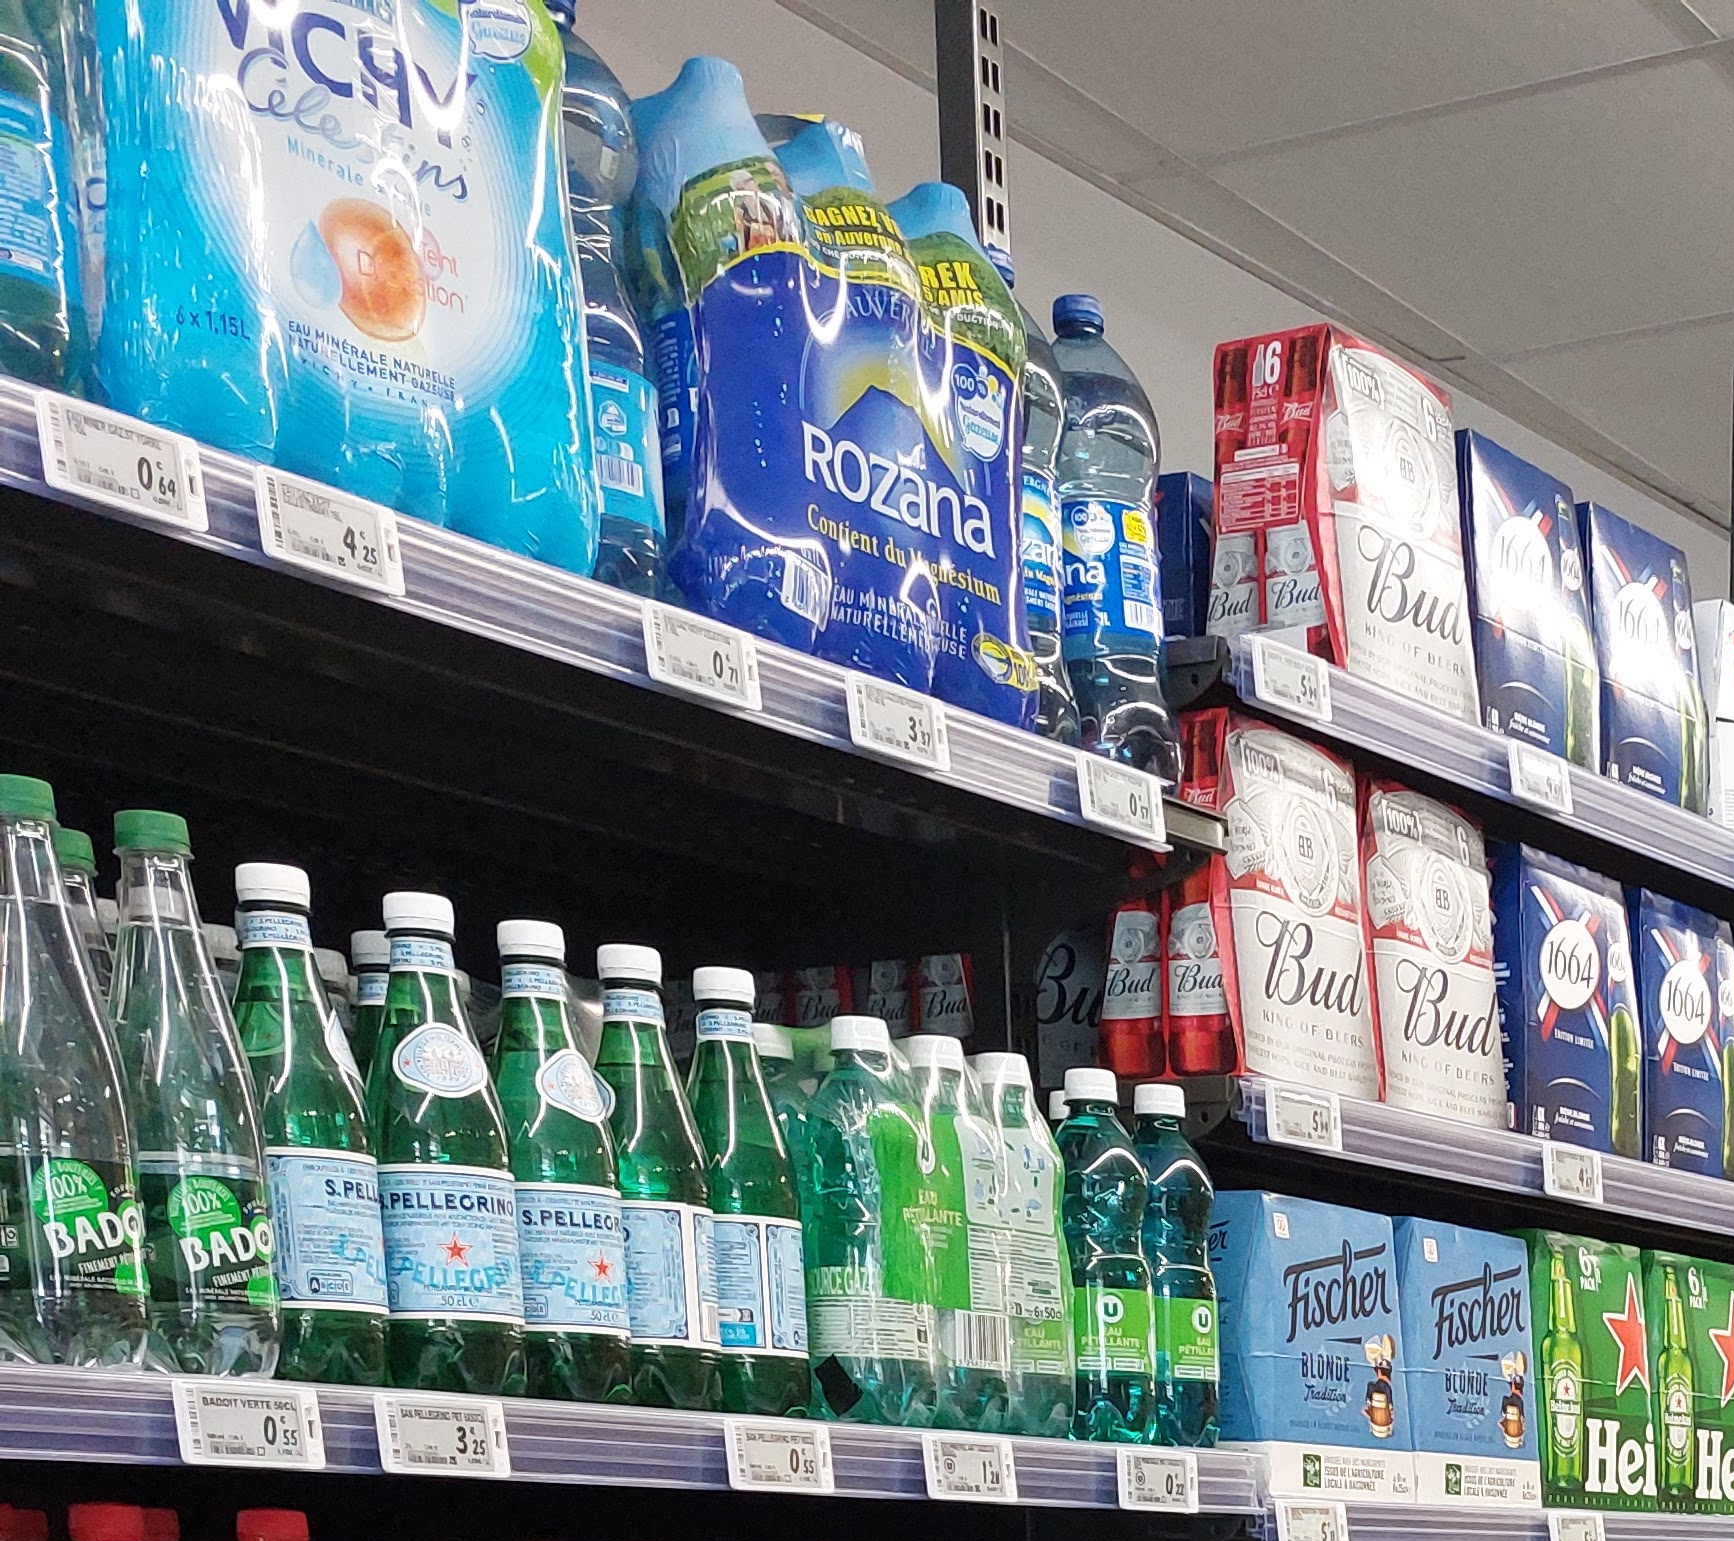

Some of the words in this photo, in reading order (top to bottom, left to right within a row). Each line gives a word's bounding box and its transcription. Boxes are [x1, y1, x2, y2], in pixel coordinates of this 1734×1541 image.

[288, 320, 311, 339] EAU
[315, 328, 389, 370] MINÉRALE
[393, 356, 456, 391] NATURELLE
[807, 503, 879, 556] Contient
[884, 541, 905, 566] du
[1272, 577, 1321, 611] Bud
[1358, 523, 1465, 648] Bud
[1107, 965, 1154, 996] Bud
[1174, 962, 1223, 991] Bud
[1255, 910, 1363, 1016] Bud
[1546, 937, 1595, 988] 1664
[1396, 958, 1496, 1055] Bud
[1666, 978, 1706, 1020] 1664
[43, 1202, 146, 1258] BADO
[179, 1218, 276, 1272] BADO
[521, 1208, 622, 1235] S.PELLEGR
[1282, 1238, 1393, 1344] Fischer
[1430, 1261, 1527, 1361] Fischer
[1301, 1350, 1351, 1384] BLONDE
[1445, 1367, 1490, 1398] BLONDE
